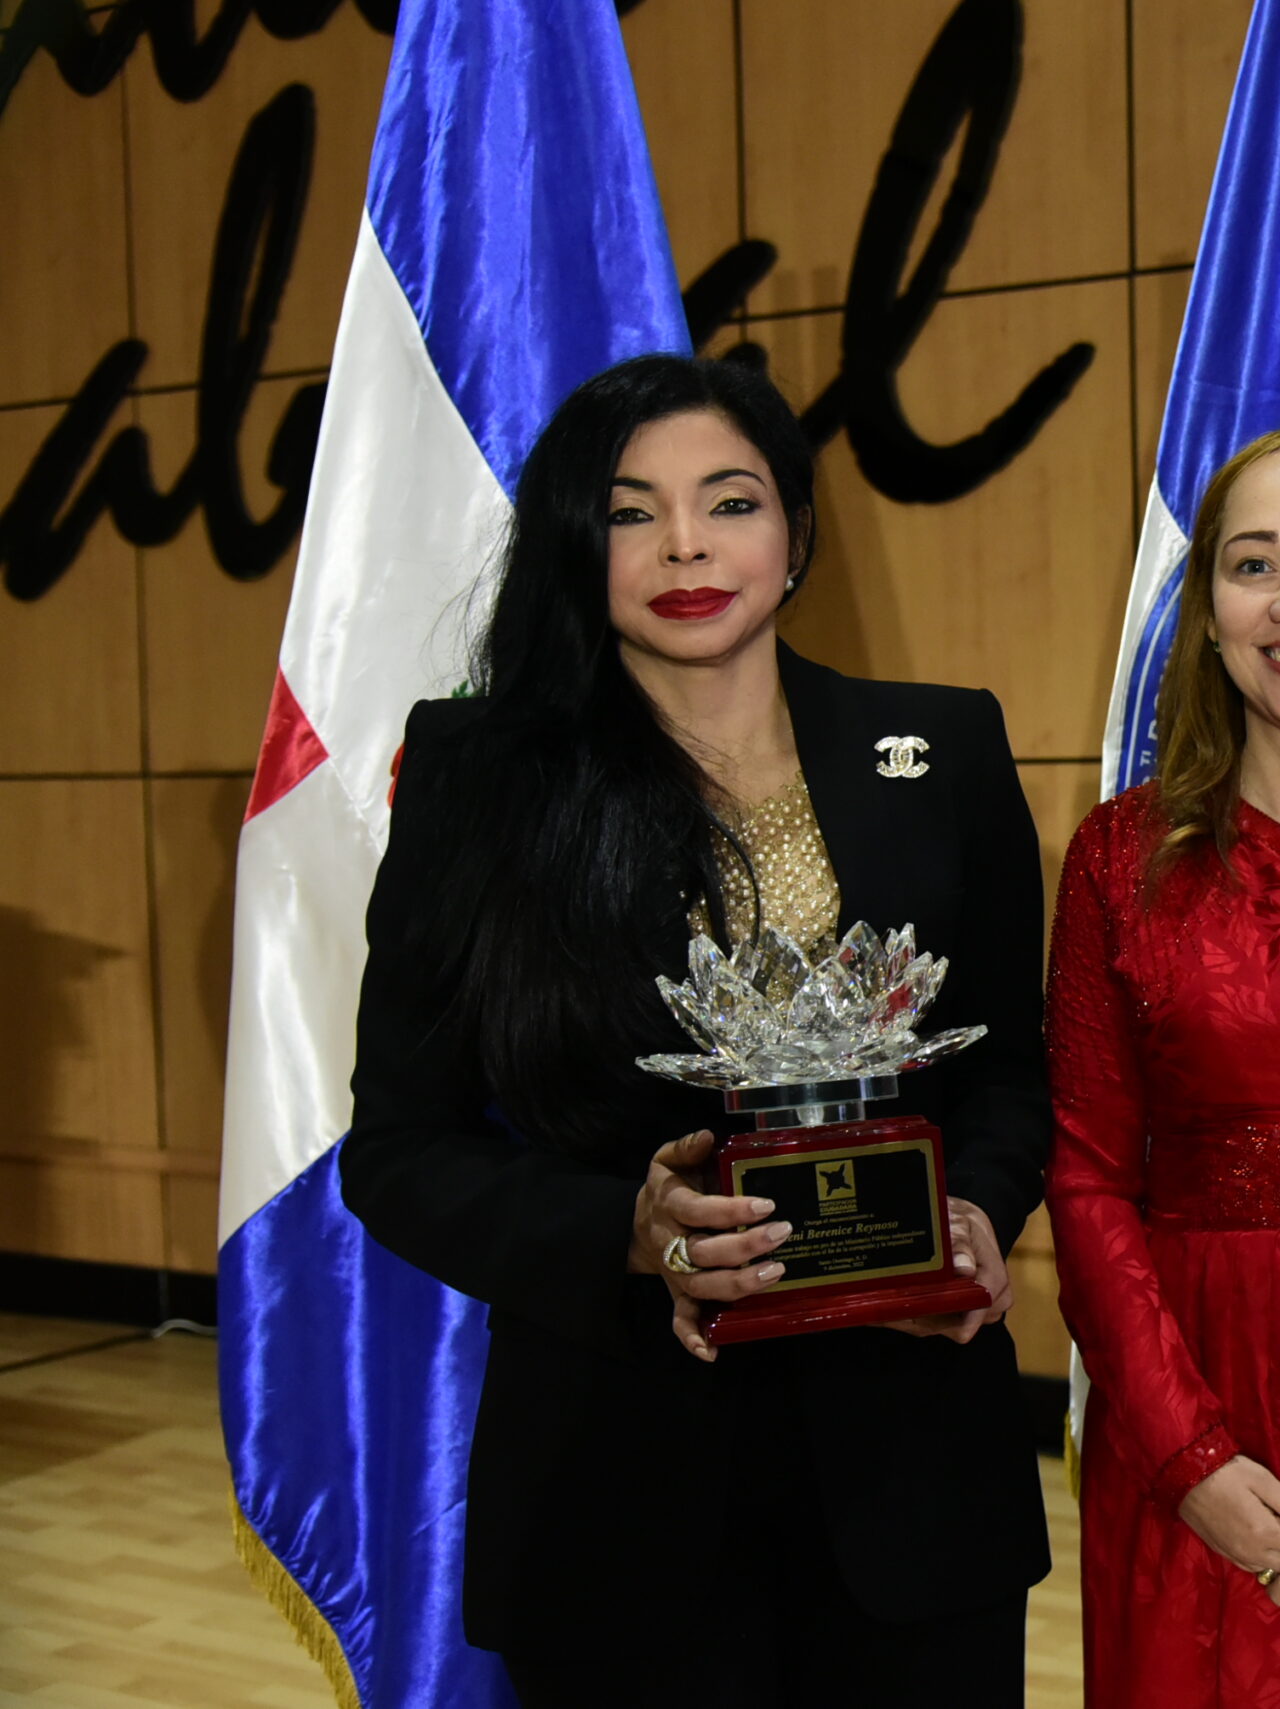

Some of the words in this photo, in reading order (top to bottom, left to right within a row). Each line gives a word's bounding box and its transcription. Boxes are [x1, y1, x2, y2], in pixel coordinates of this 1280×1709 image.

[788, 1230, 804, 1241] eni
[807, 1226, 854, 1240] Berenice
[856, 1221, 899, 1234] Reynoso
